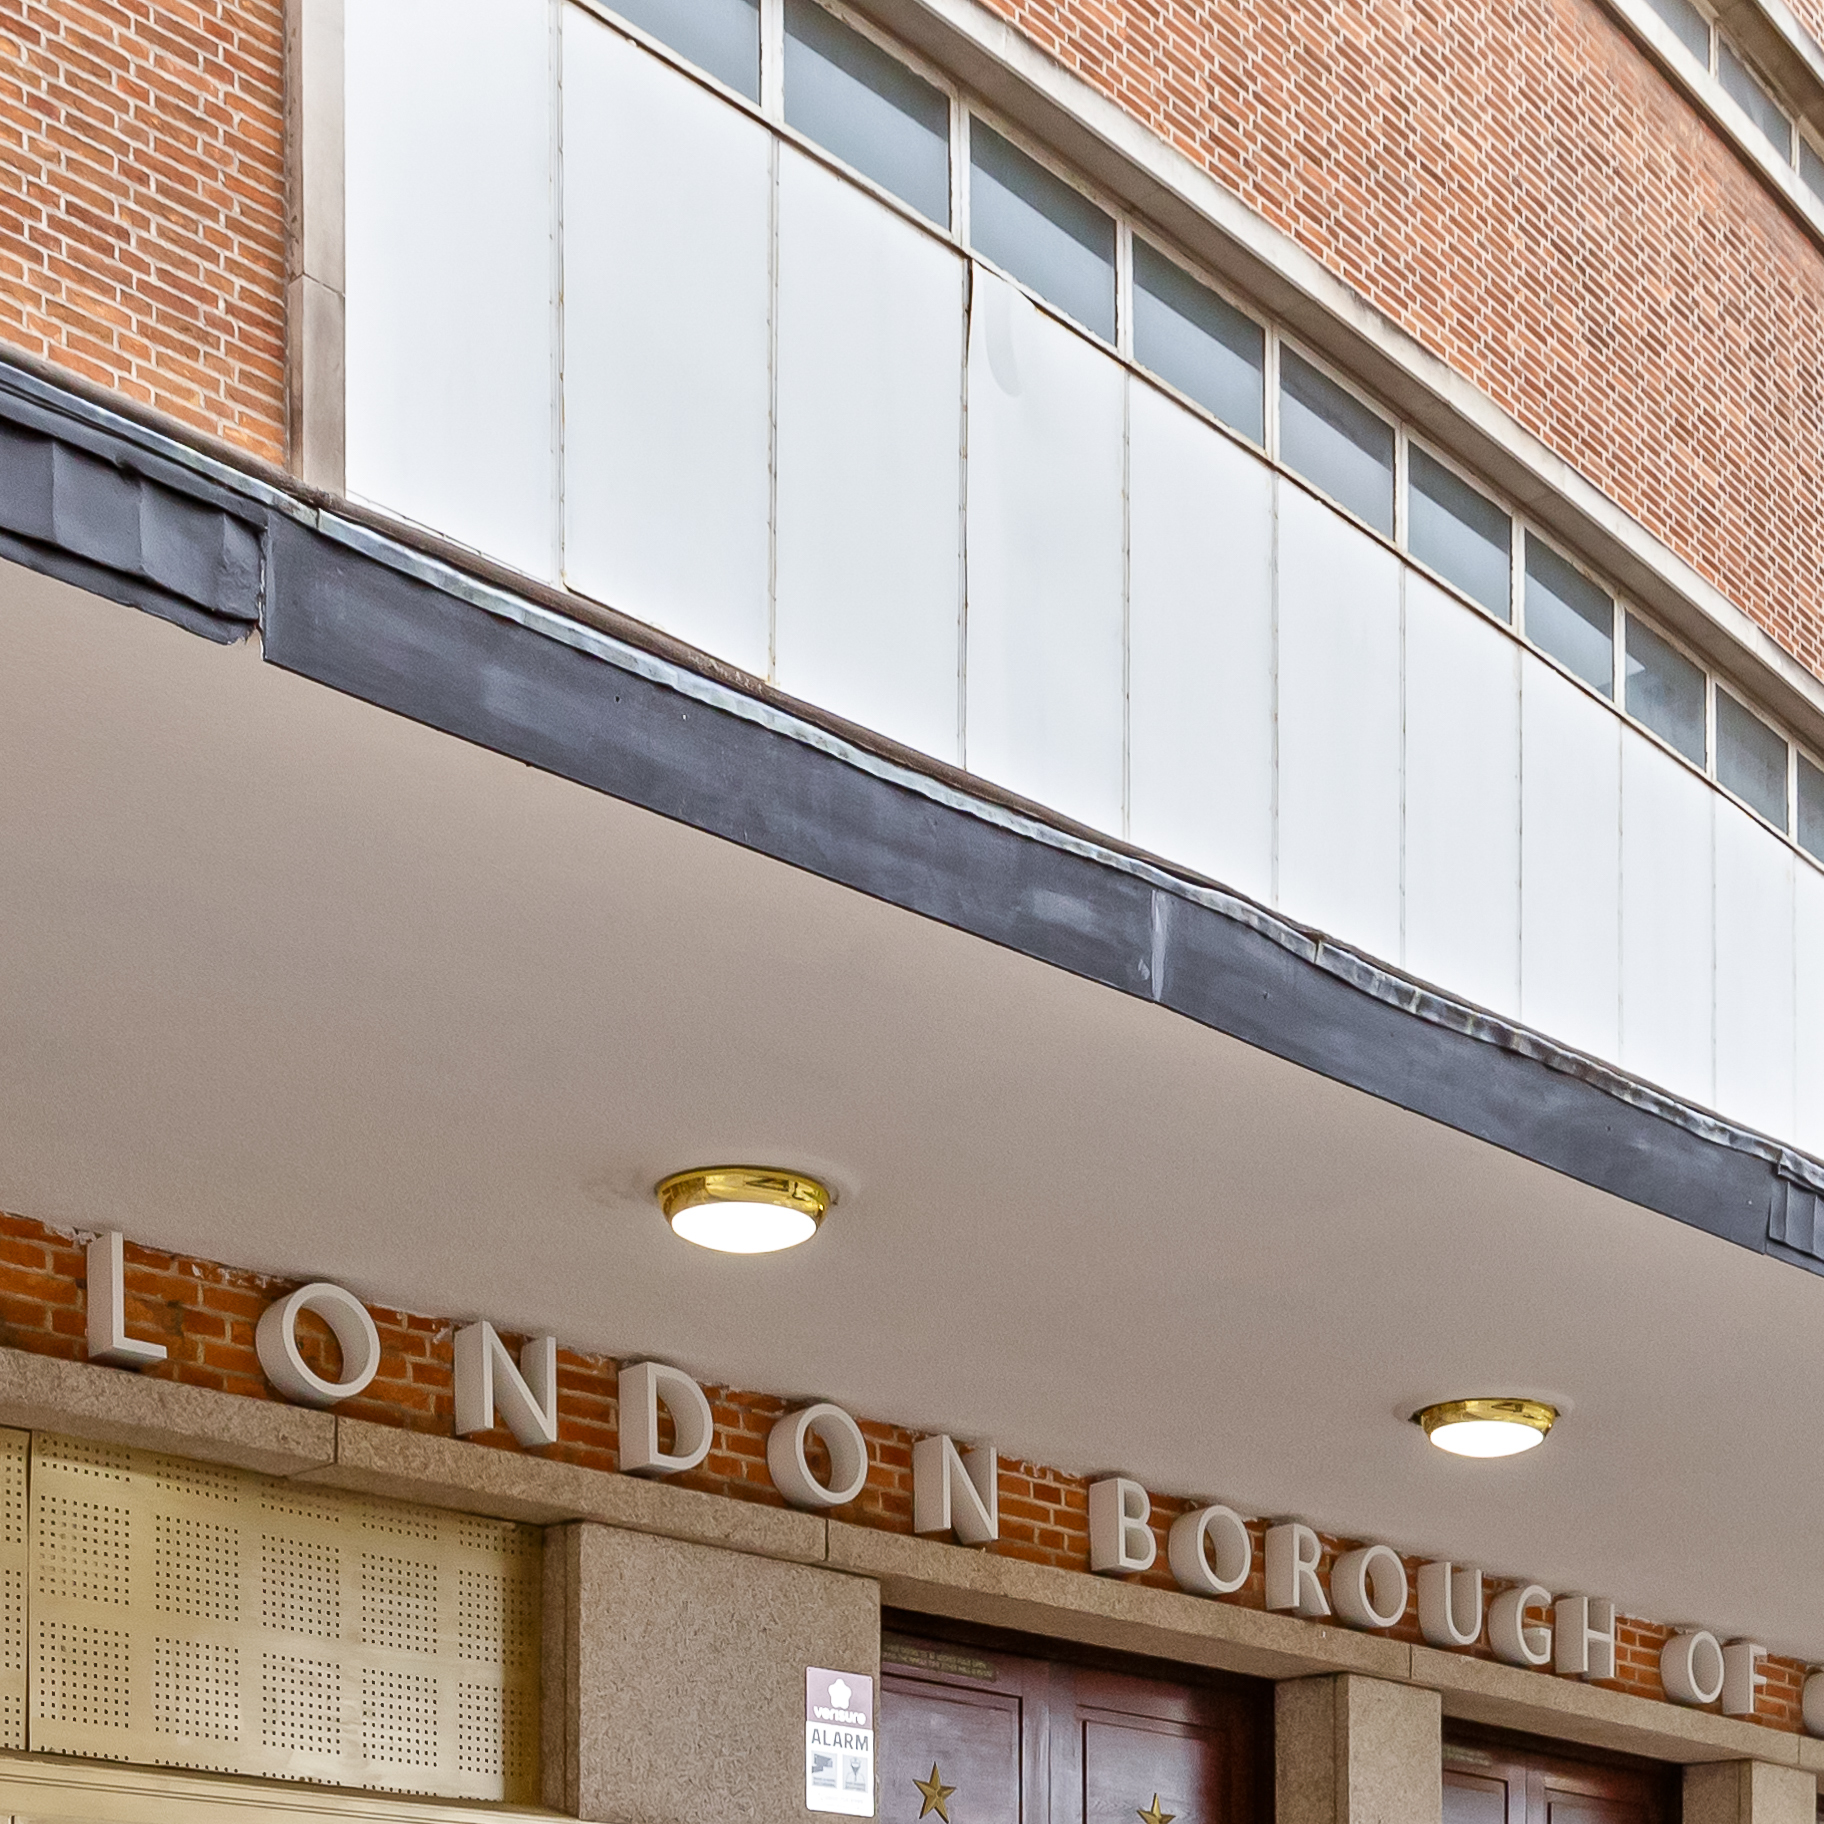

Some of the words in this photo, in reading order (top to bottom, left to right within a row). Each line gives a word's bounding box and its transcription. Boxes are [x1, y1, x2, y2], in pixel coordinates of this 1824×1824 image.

[87, 1231, 998, 1544] LONDON
[1090, 1477, 1616, 1680] BOROUGH
[1660, 1629, 1768, 1715] OF
[811, 1728, 869, 1752] ALARM
